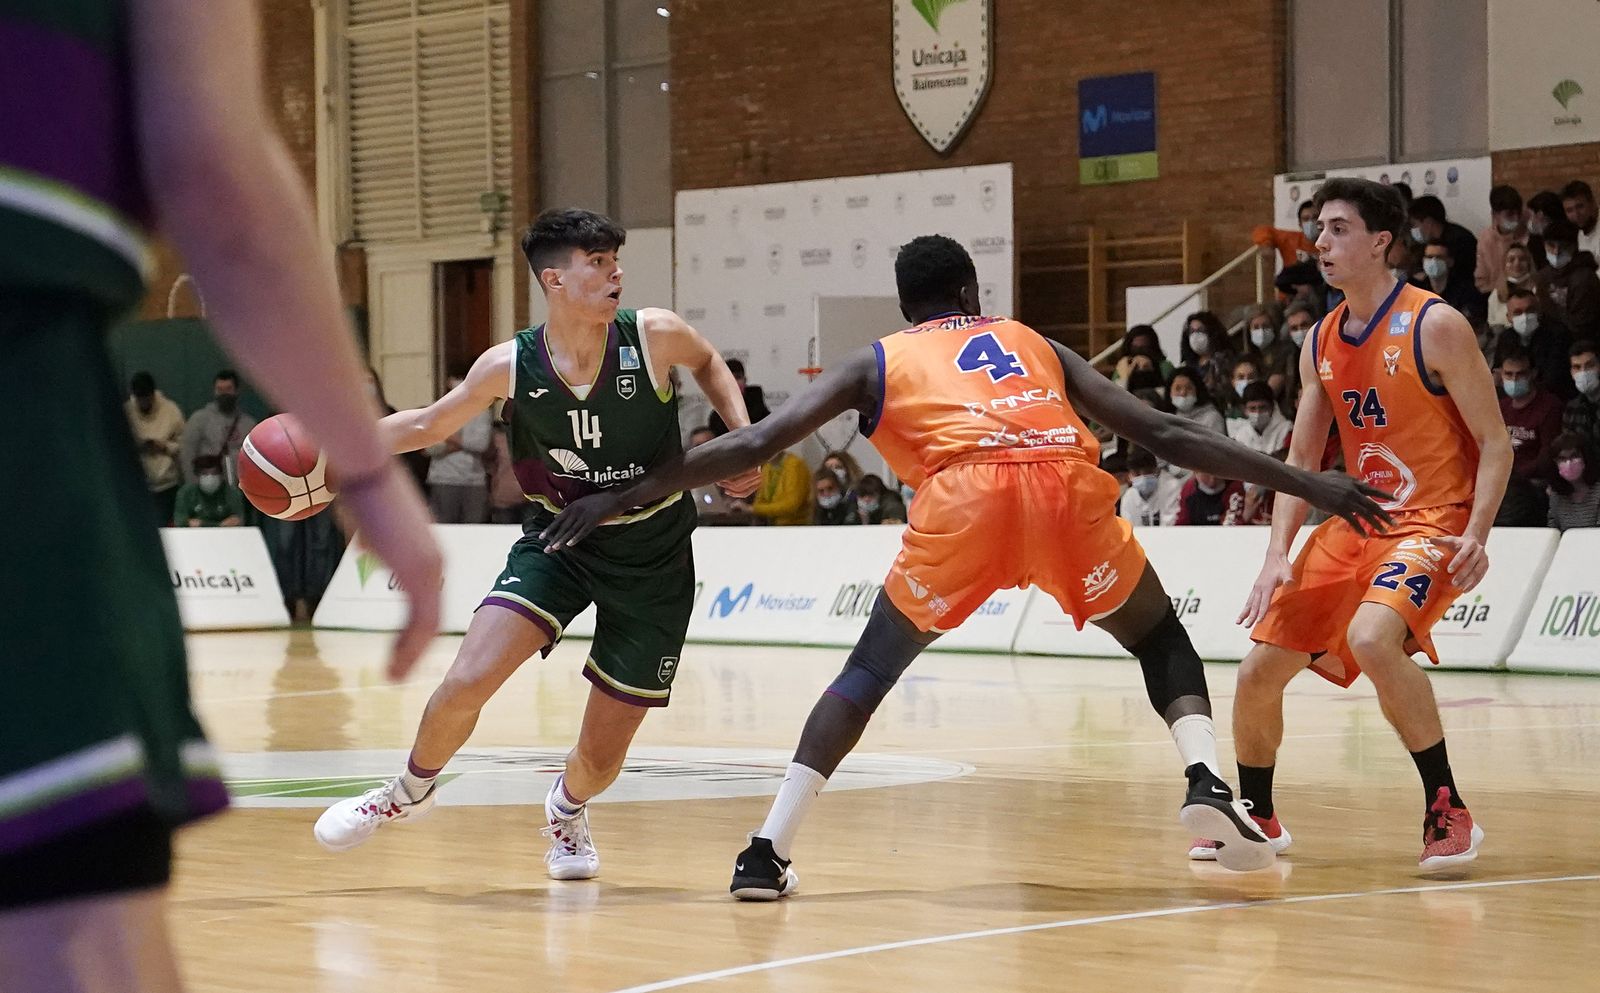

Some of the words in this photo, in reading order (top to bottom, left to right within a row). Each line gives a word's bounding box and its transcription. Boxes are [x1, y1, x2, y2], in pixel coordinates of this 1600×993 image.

[912, 43, 967, 67] Unicaja
[954, 331, 1028, 384] 4
[990, 388, 1062, 410] FINCA
[1342, 387, 1388, 429] 24
[567, 410, 602, 449] 14
[585, 462, 645, 484] Unicaja
[1372, 561, 1432, 609] 24
[755, 593, 817, 611] Movistar
